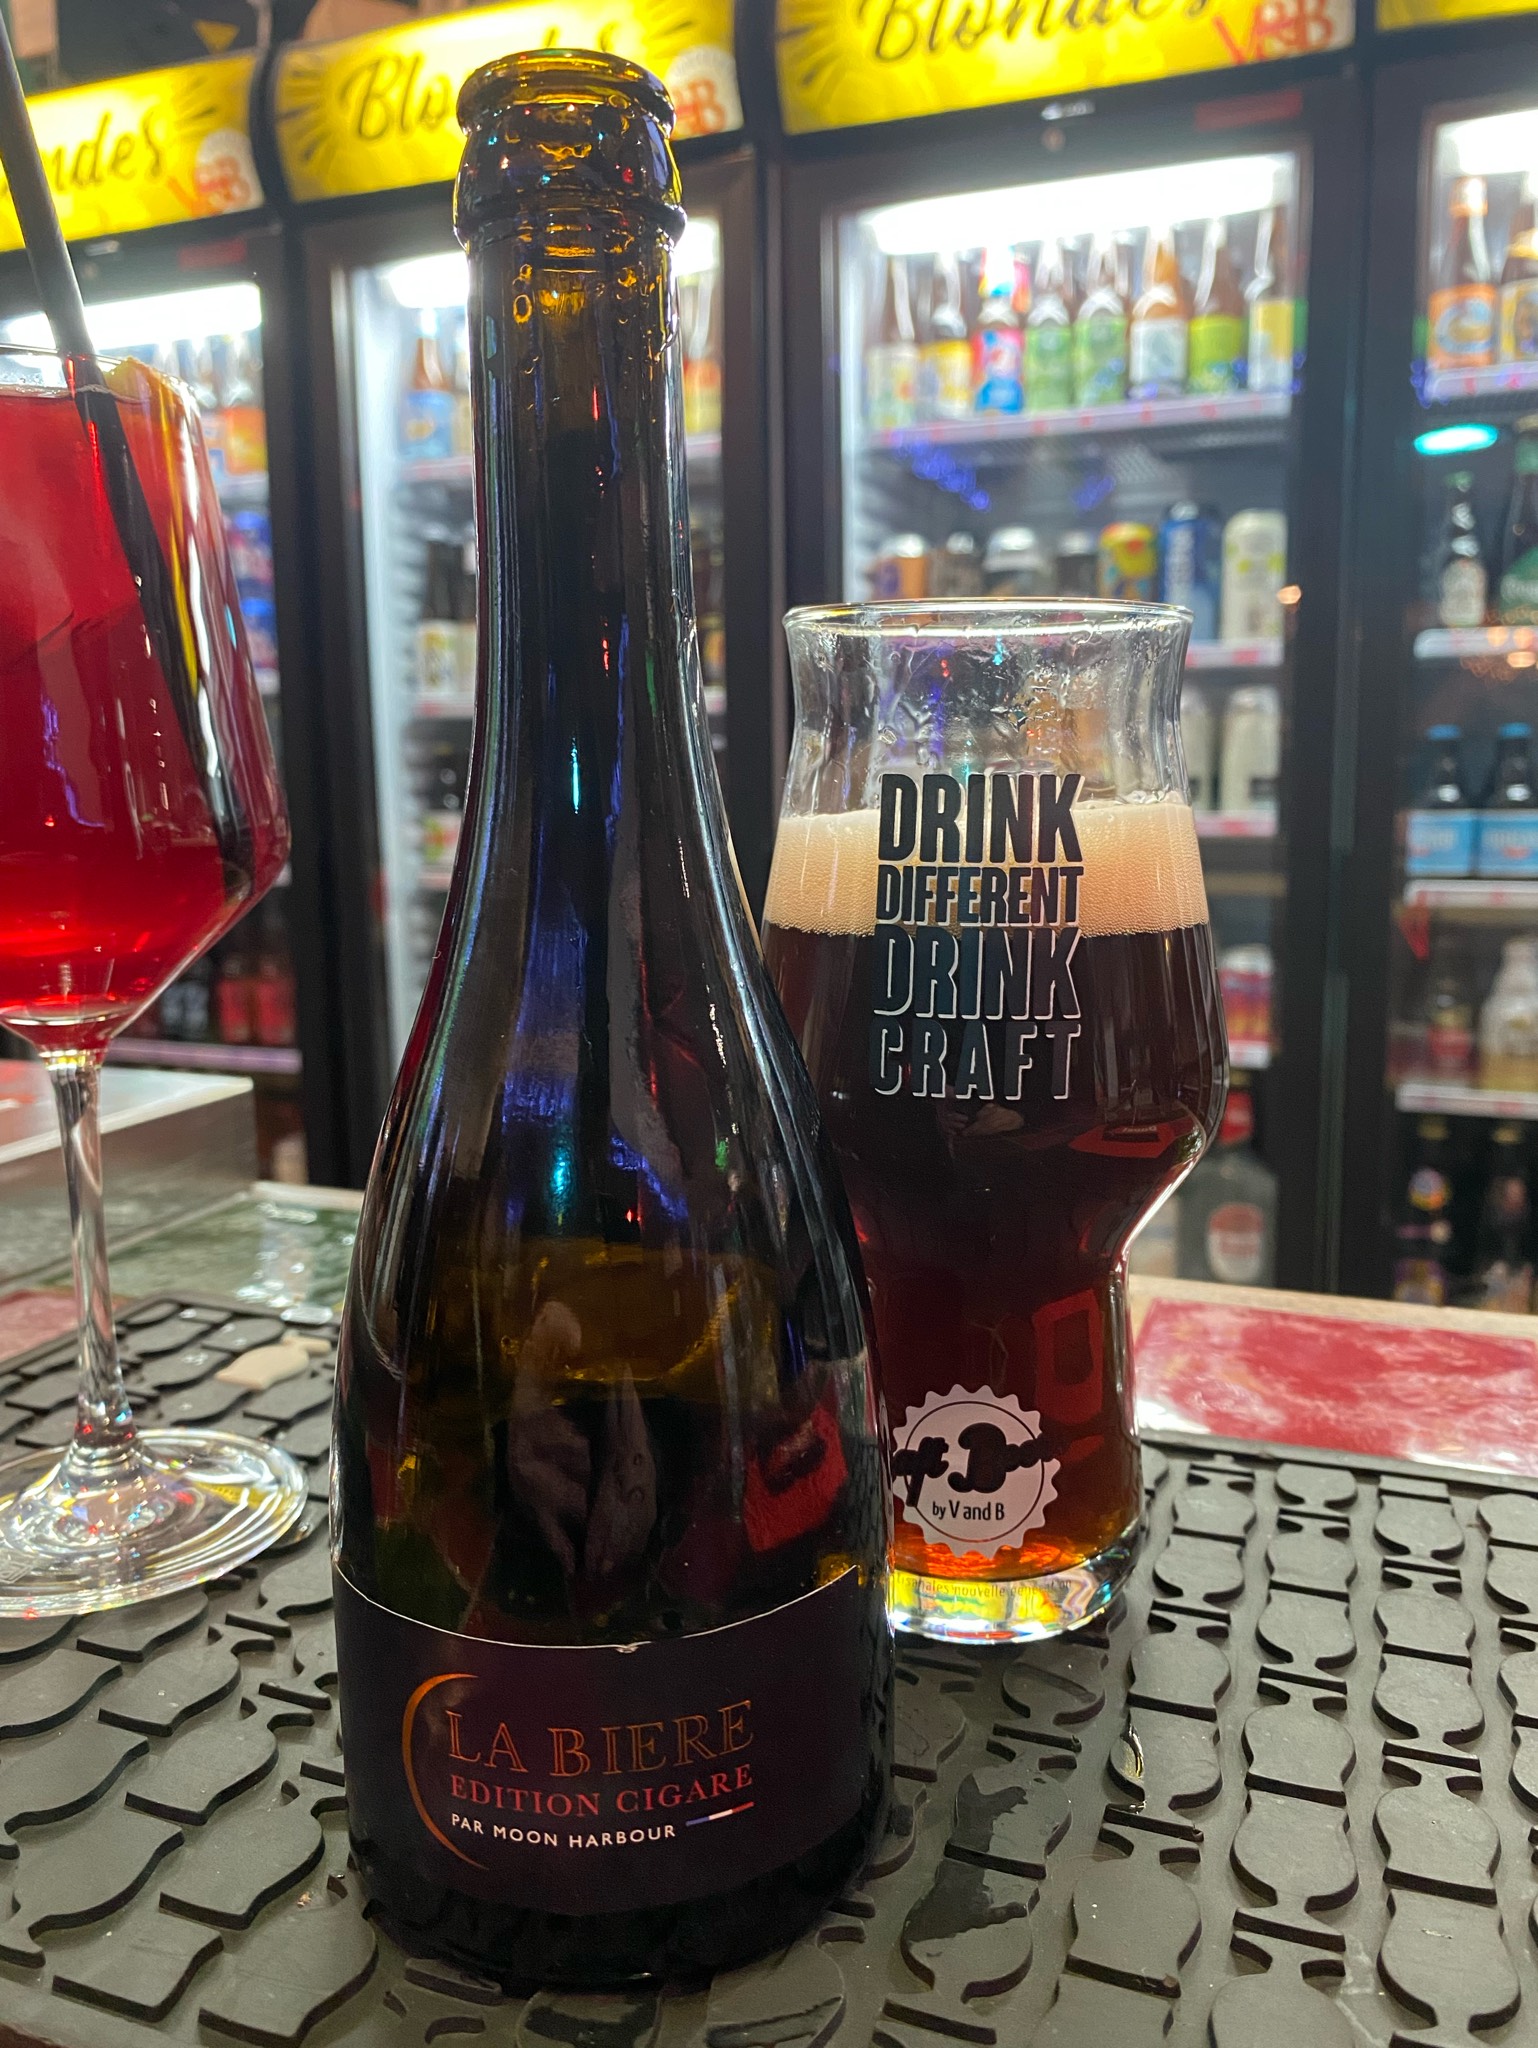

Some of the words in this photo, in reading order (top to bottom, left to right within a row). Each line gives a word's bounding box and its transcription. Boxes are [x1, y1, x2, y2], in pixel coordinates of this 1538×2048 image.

[878, 773, 1085, 864] DRINK
[876, 863, 1084, 927] DIFFERENT
[872, 924, 1082, 1020] DRINK
[870, 1018, 1081, 1100] CRAFT
[932, 1500, 946, 1520] by
[948, 1499, 960, 1519] V
[963, 1501, 991, 1521] and
[995, 1502, 1005, 1521] B
[446, 1709, 528, 1774] LA
[547, 1699, 754, 1778] BIERE
[451, 1774, 600, 1818] EDITION
[616, 1763, 753, 1813] CIGARE
[451, 1812, 484, 1835] PAR
[492, 1823, 558, 1847] MOON
[568, 1823, 676, 1849] HARBOUR
